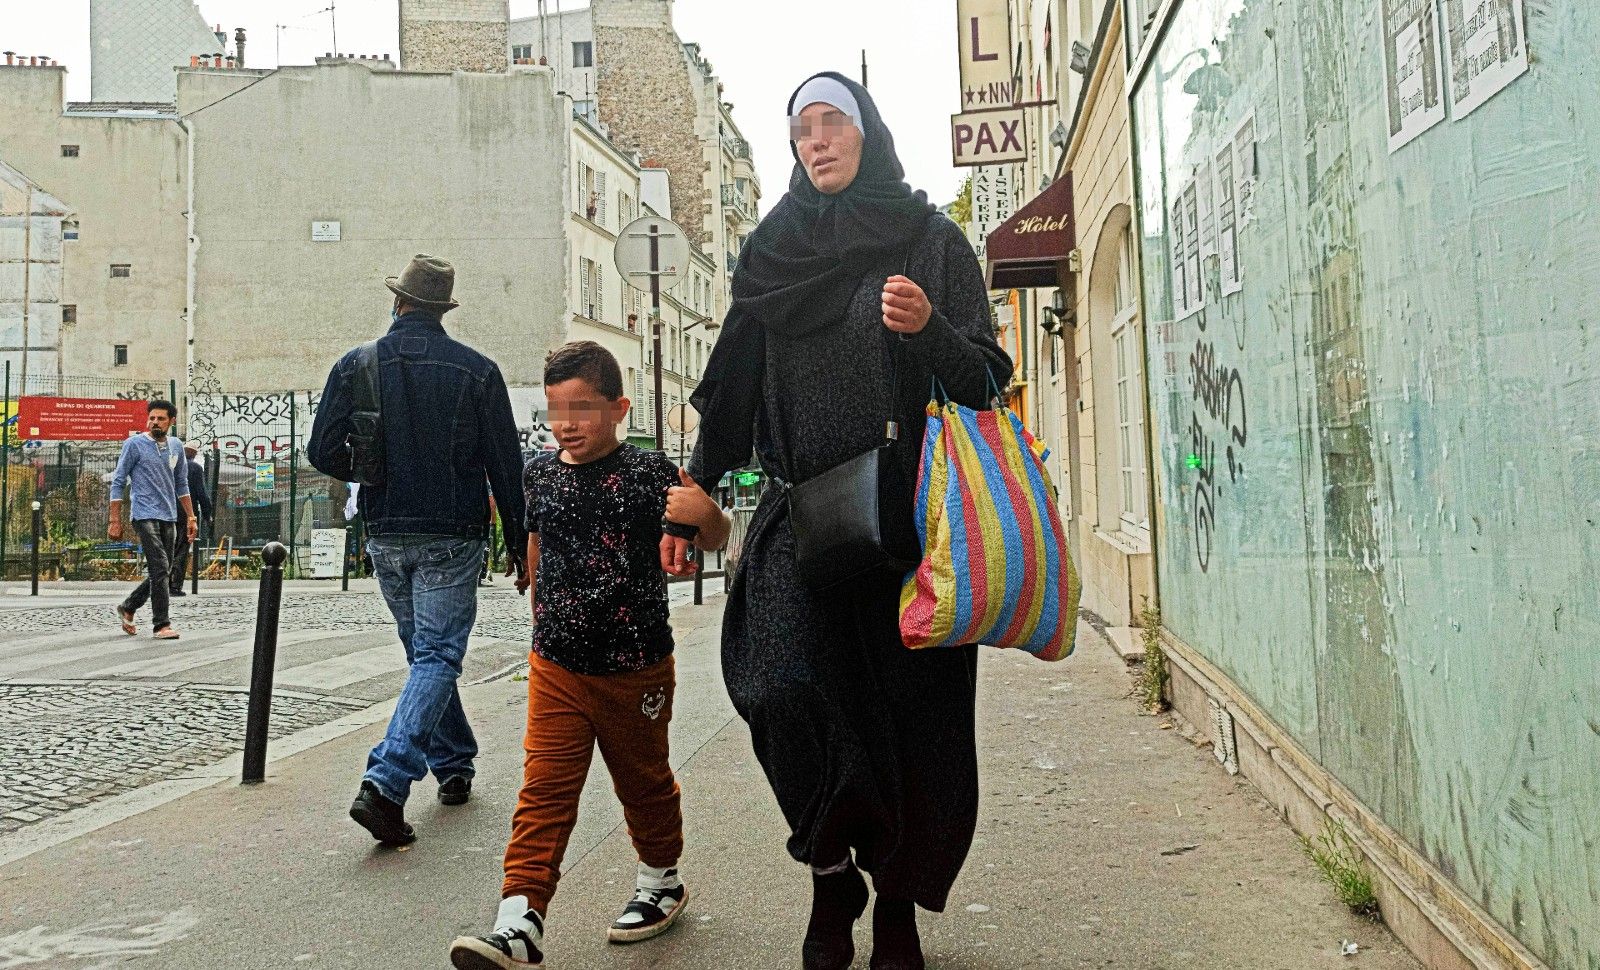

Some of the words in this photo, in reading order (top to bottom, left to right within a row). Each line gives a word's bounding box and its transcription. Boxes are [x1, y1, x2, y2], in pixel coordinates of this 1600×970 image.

[970, 16, 999, 62] L
[954, 119, 1024, 157] PAX
[1014, 213, 1070, 235] Hôtel
